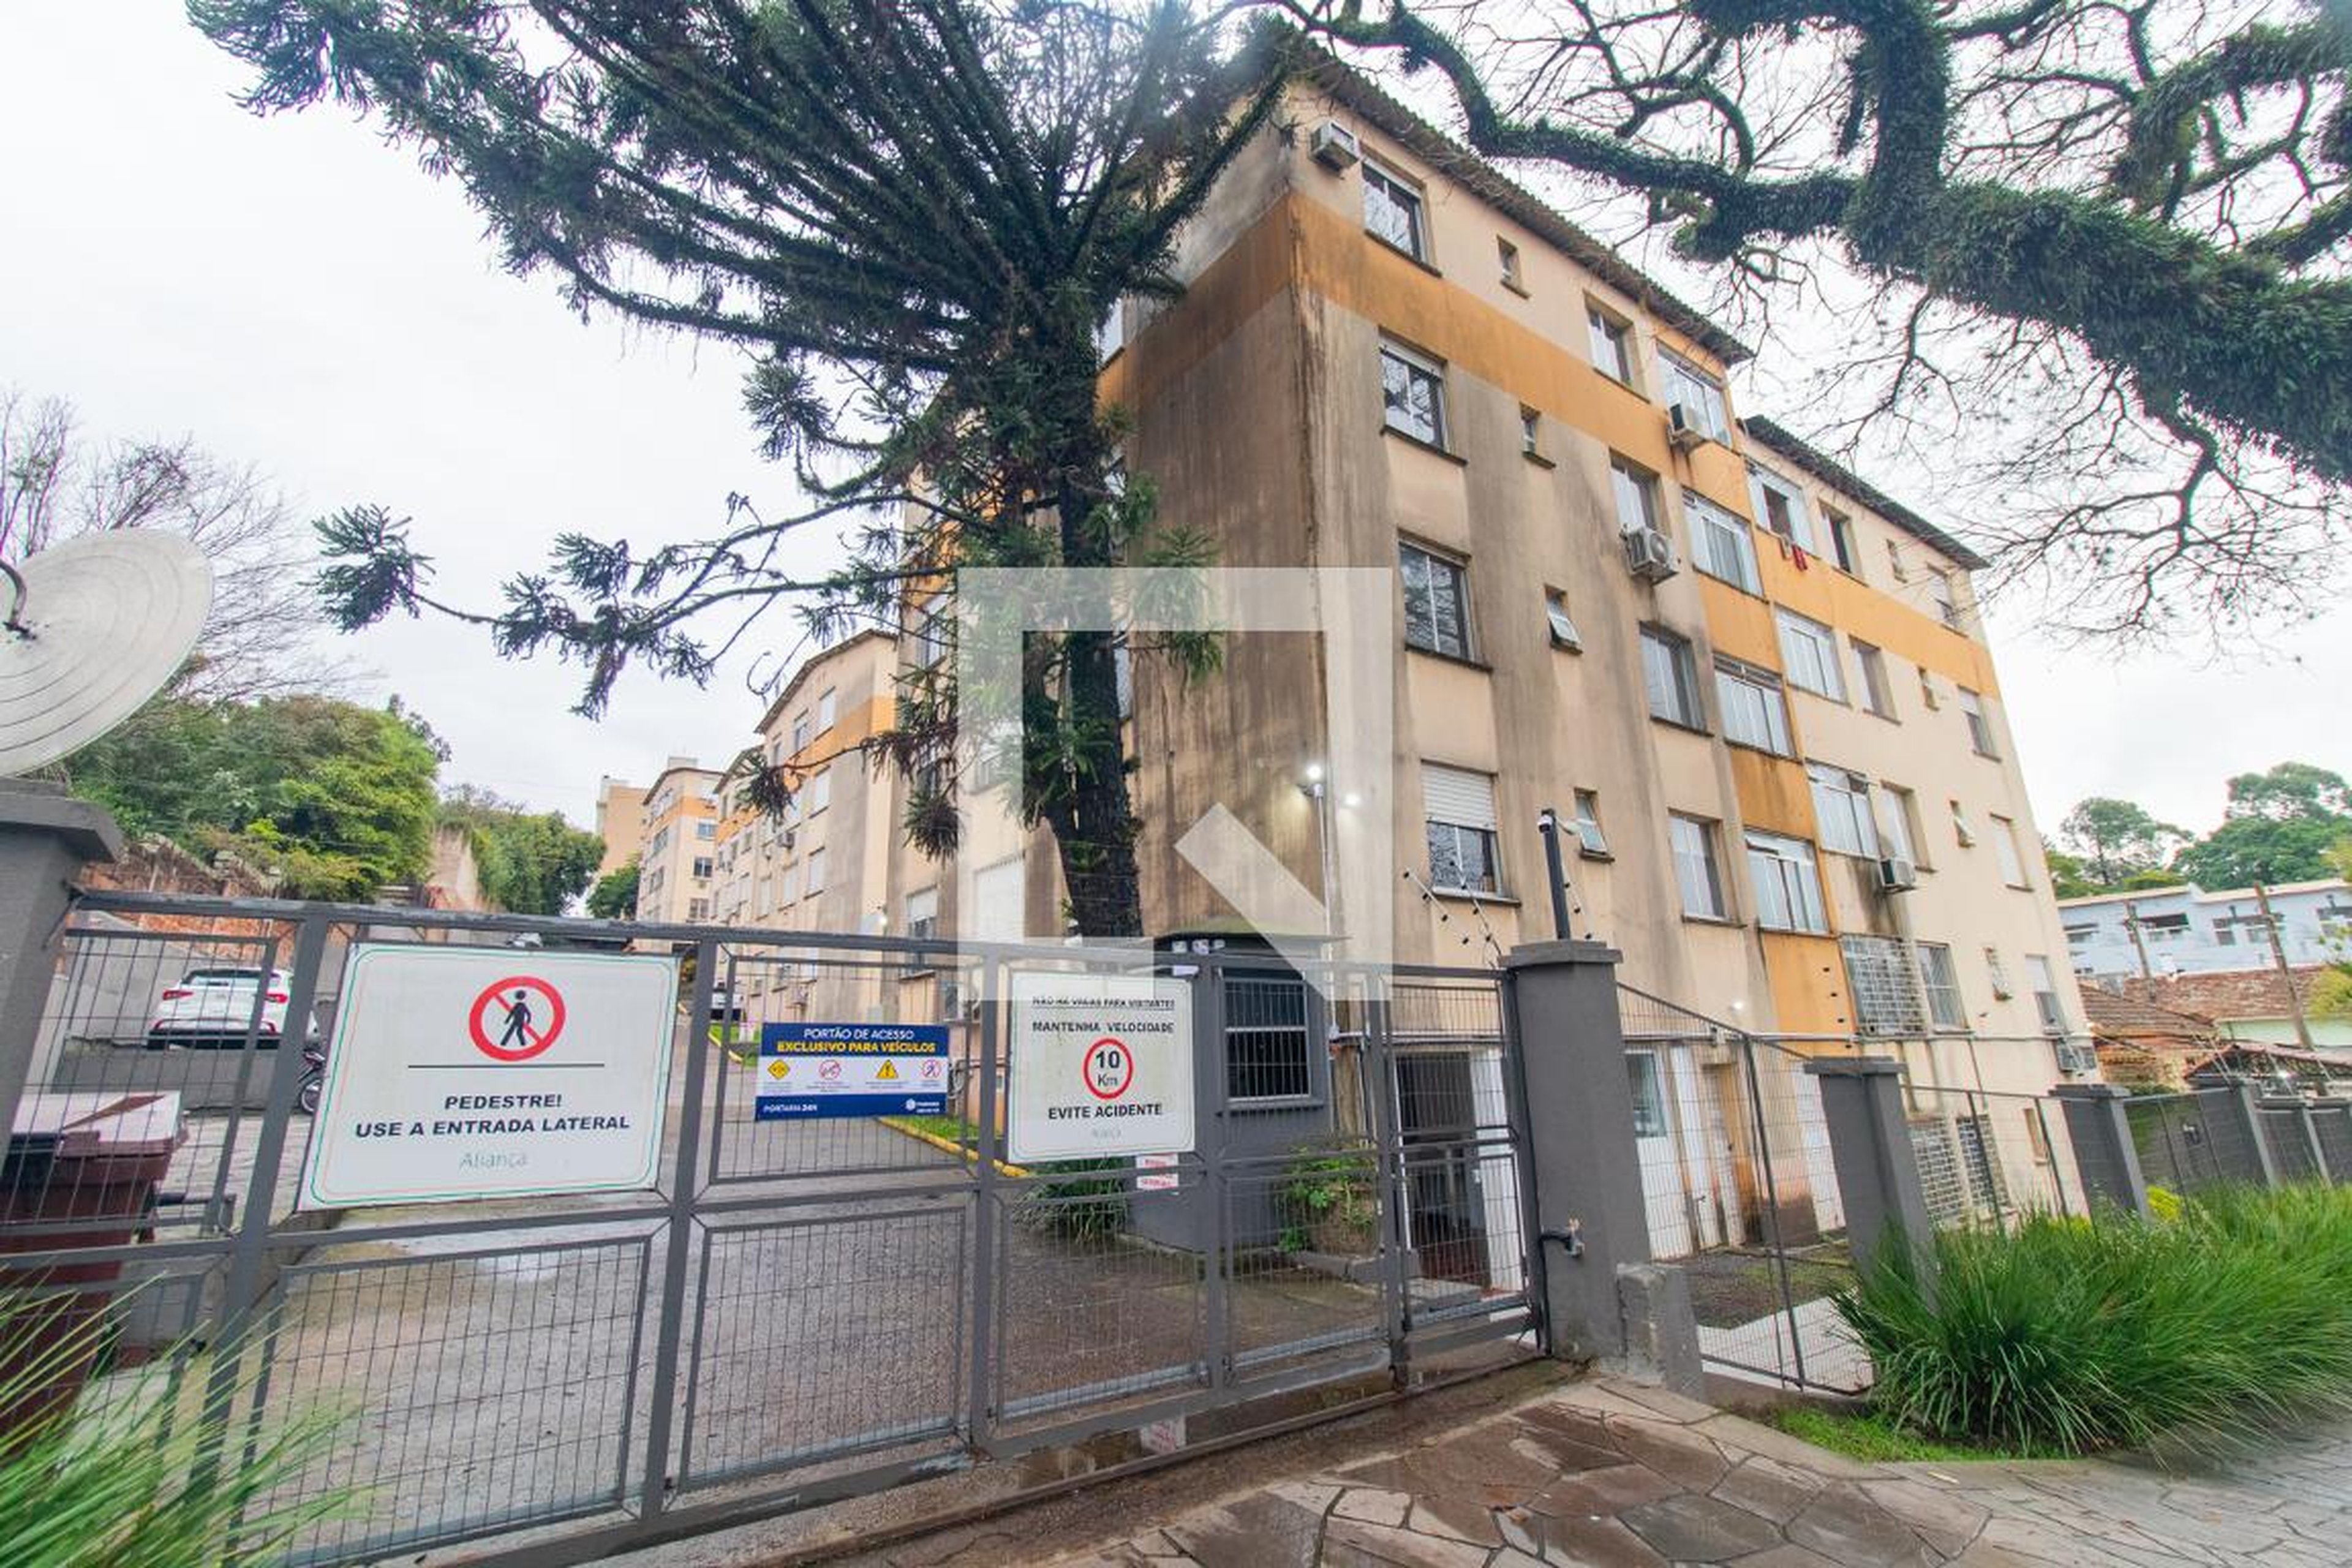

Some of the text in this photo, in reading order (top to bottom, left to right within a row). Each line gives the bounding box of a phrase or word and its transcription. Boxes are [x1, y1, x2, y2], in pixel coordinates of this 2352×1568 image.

[1104, 998, 1126, 1006] PARA
[804, 1026, 914, 1039] PORTÃO DE ACESSO
[1033, 1022, 1174, 1033] MANTENHA VELOCIDADE
[777, 1041, 935, 1052] EXCLUSIVO PARA VEÍCULOS
[1096, 1050, 1120, 1068] 10
[1098, 1074, 1118, 1086] Km
[445, 1094, 562, 1109] PEDESTRE!
[1048, 1103, 1163, 1120] EVITE ACIDENTE
[356, 1116, 630, 1137] USE A ENTRADA LATERAL
